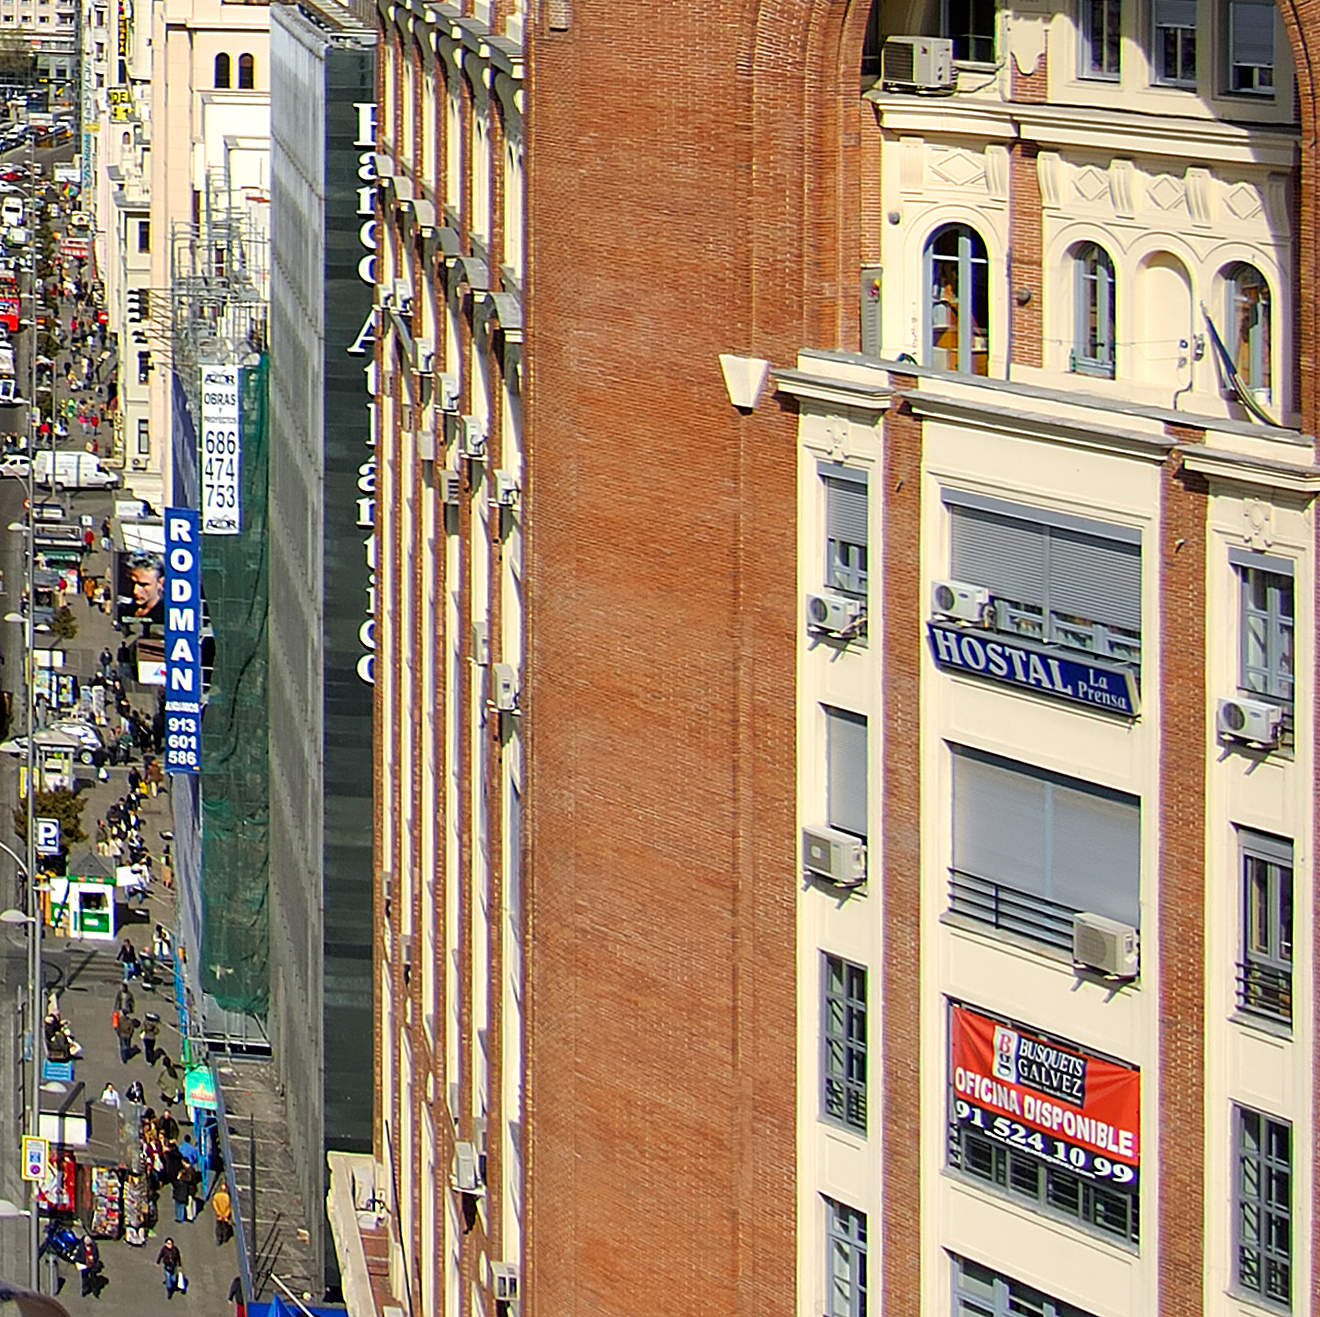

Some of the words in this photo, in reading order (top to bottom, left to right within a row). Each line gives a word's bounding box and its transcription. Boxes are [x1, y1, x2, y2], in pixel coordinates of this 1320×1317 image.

[204, 392, 236, 406] OBRAS
[205, 430, 236, 455] 686
[204, 457, 236, 481] 474
[205, 484, 236, 509] 753
[168, 518, 194, 692] RODMAN
[932, 627, 1073, 696] HOSTAL
[1088, 668, 1108, 690] La
[1077, 681, 1127, 710] Prensa
[168, 717, 196, 732] 913
[168, 734, 197, 749] 601
[168, 750, 197, 765] 586
[38, 822, 57, 846] P
[1018, 1037, 1085, 1077] BUSQUETS
[1017, 1058, 1083, 1097] GALVEZ
[954, 1066, 1021, 1116] OFICINA
[1023, 1094, 1134, 1158] DISPONIBLE
[955, 1099, 986, 1129] 91
[992, 1116, 1045, 1151] 524
[1053, 1141, 1086, 1168] 10
[1093, 1156, 1134, 1184] 99
